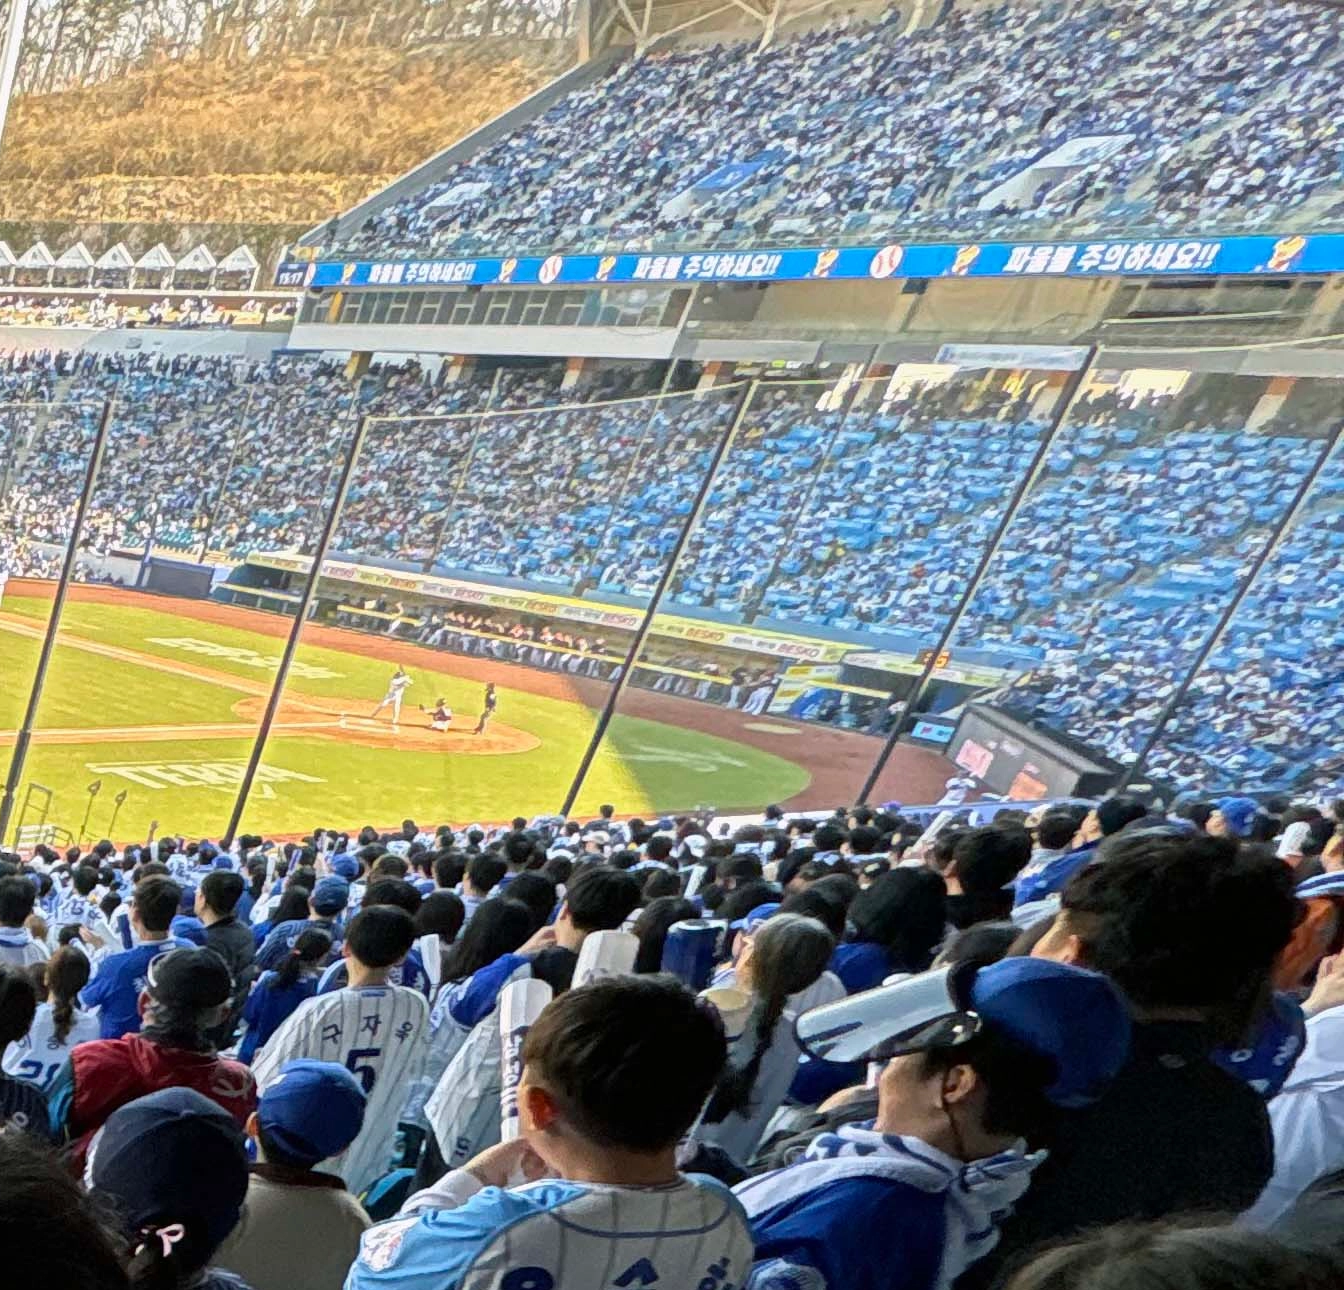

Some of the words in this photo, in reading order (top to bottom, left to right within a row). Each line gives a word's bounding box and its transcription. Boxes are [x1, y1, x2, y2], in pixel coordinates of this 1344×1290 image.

[405, 262, 476, 283] 주의하세요!!
[632, 255, 683, 280] 파울볼
[683, 253, 782, 279] 주의하세요!!
[1002, 245, 1077, 274] 파울볼
[1077, 242, 1221, 272] 주의하세요!!
[322, 1013, 414, 1046] 구자욱
[345, 1047, 381, 1096] 5
